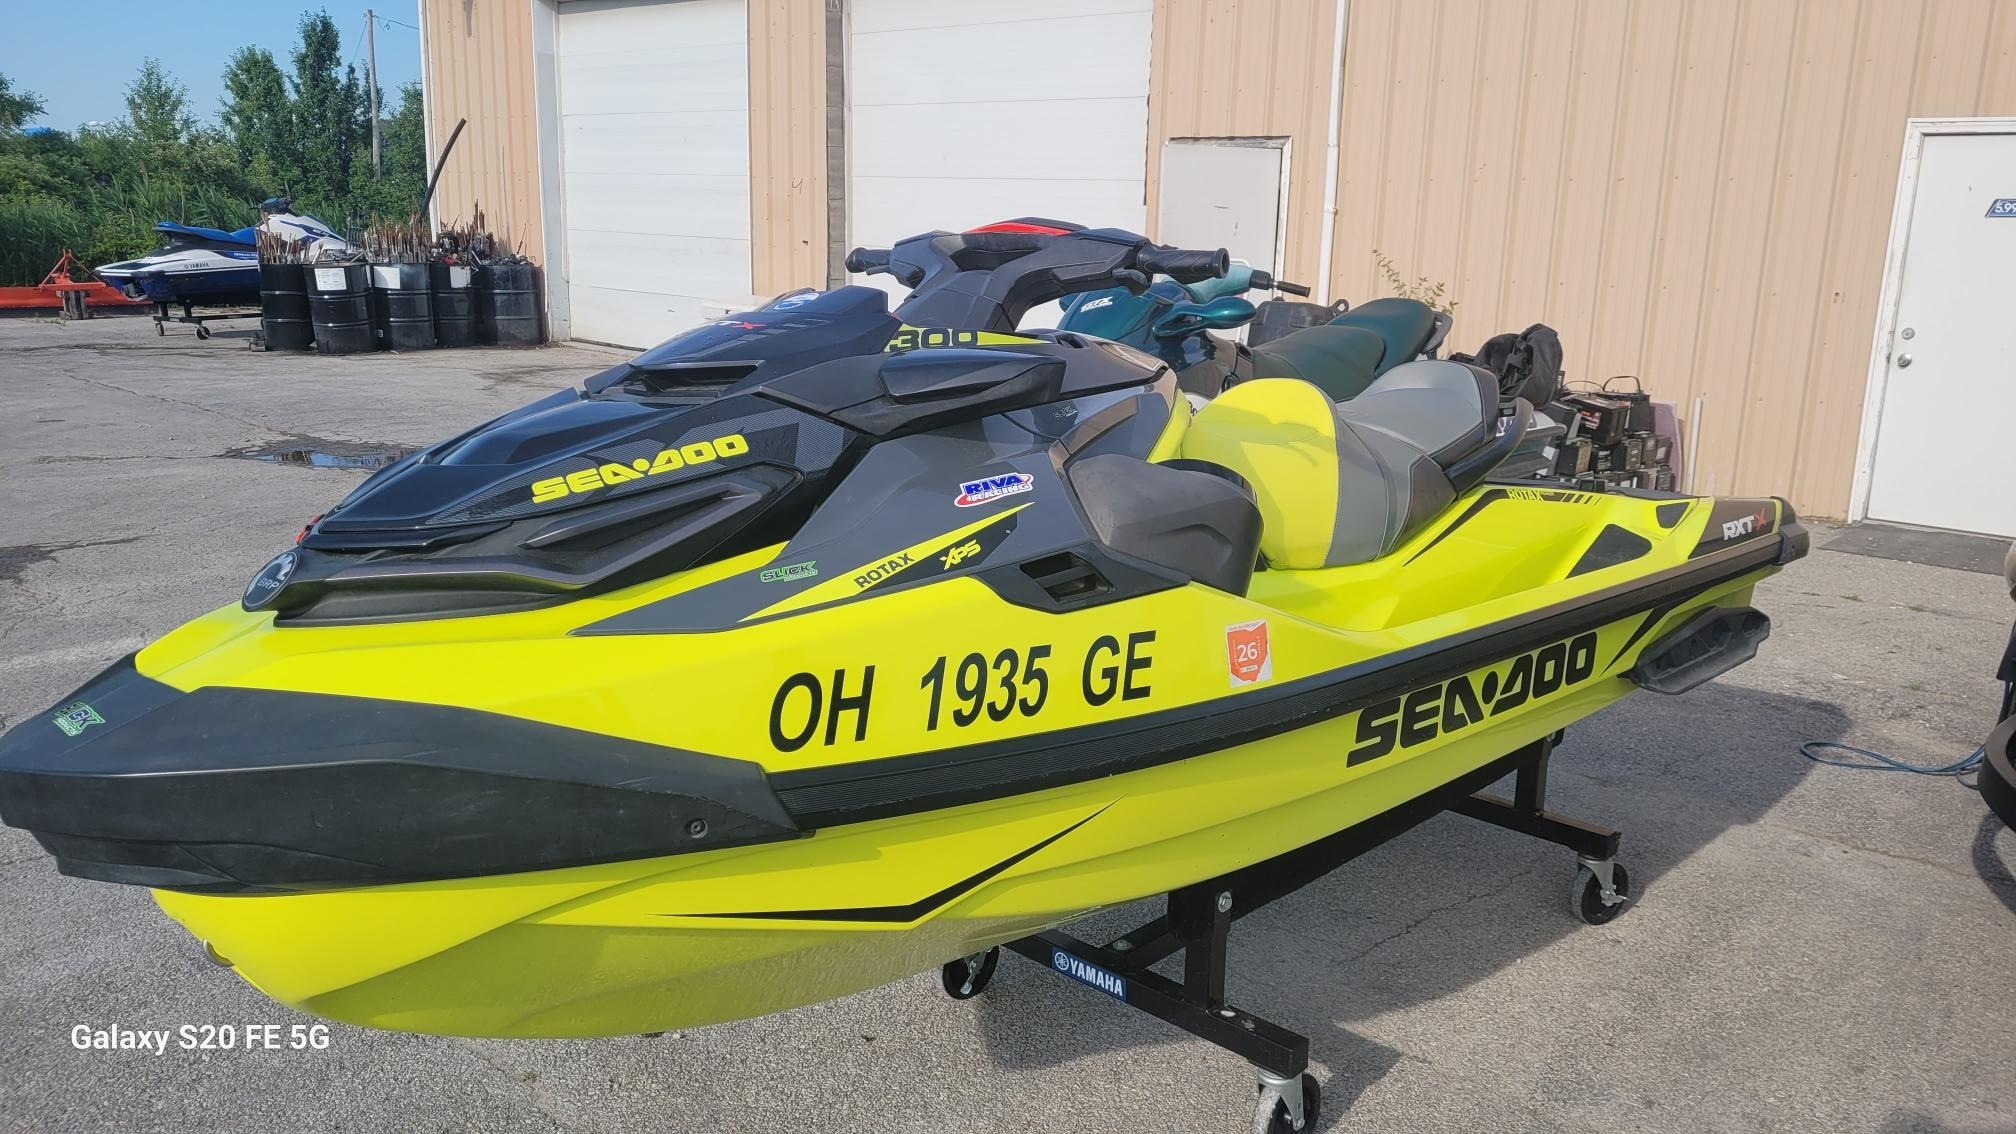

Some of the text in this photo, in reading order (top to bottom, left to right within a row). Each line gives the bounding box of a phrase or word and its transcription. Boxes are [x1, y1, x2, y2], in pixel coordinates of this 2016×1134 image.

[889, 329, 978, 353] 300
[965, 475, 1023, 495] RIVA
[966, 484, 1030, 501] RACING
[1507, 487, 1545, 502] ROTAX
[939, 539, 982, 571] XPS
[761, 560, 816, 582] SLICK
[853, 552, 915, 588] ROTAX
[257, 577, 280, 590] BRP
[1237, 642, 1258, 663] 26
[769, 630, 1157, 753] OH 1935 GE
[1069, 957, 1124, 997] YAMAHA
